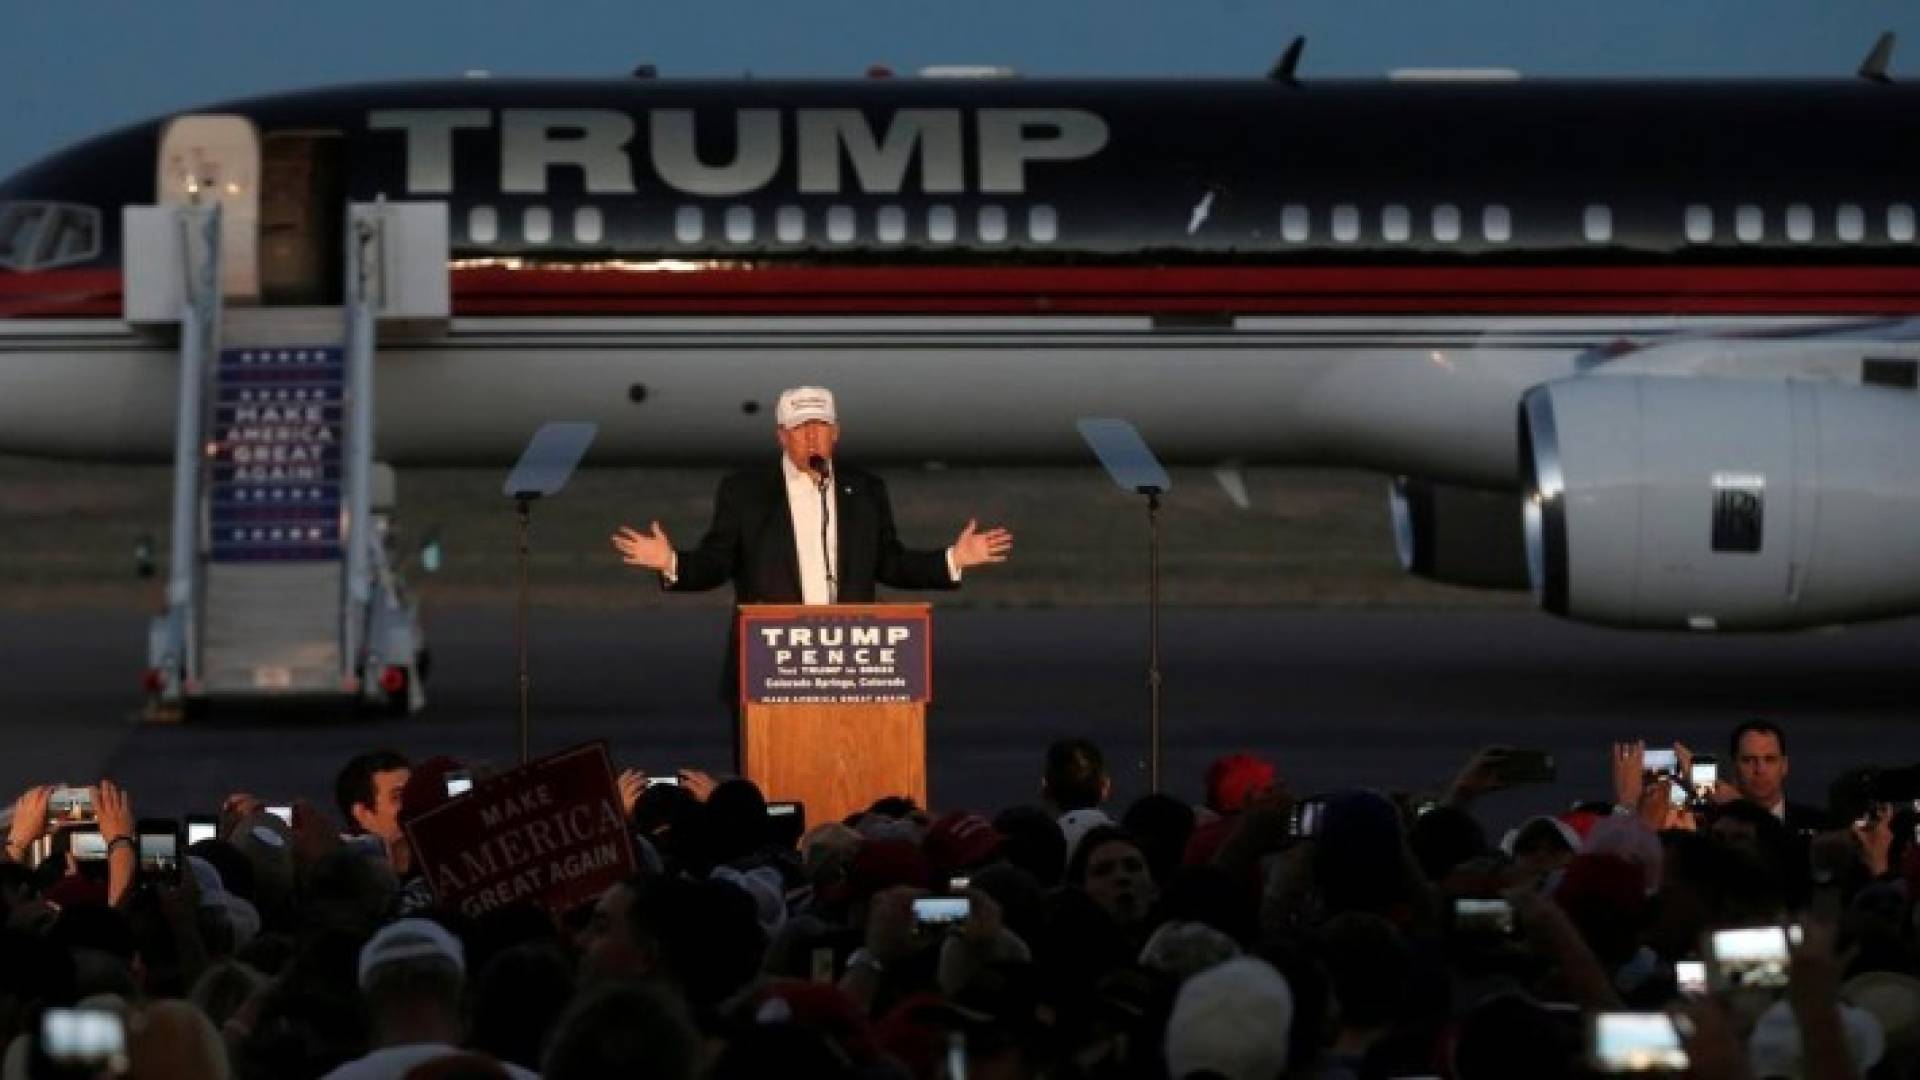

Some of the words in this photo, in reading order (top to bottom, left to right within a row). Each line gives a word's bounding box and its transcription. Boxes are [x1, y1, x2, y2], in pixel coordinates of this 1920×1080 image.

[368, 107, 1109, 196] TRUMP
[235, 405, 322, 424] MAKE
[227, 425, 333, 443] AMERICA
[234, 444, 321, 463] GREAT
[761, 626, 911, 646] TRUMP
[776, 648, 895, 665] PENCE
[479, 783, 554, 827] MAKE
[438, 797, 622, 890] AMERICA
[461, 867, 543, 920] GREAT
